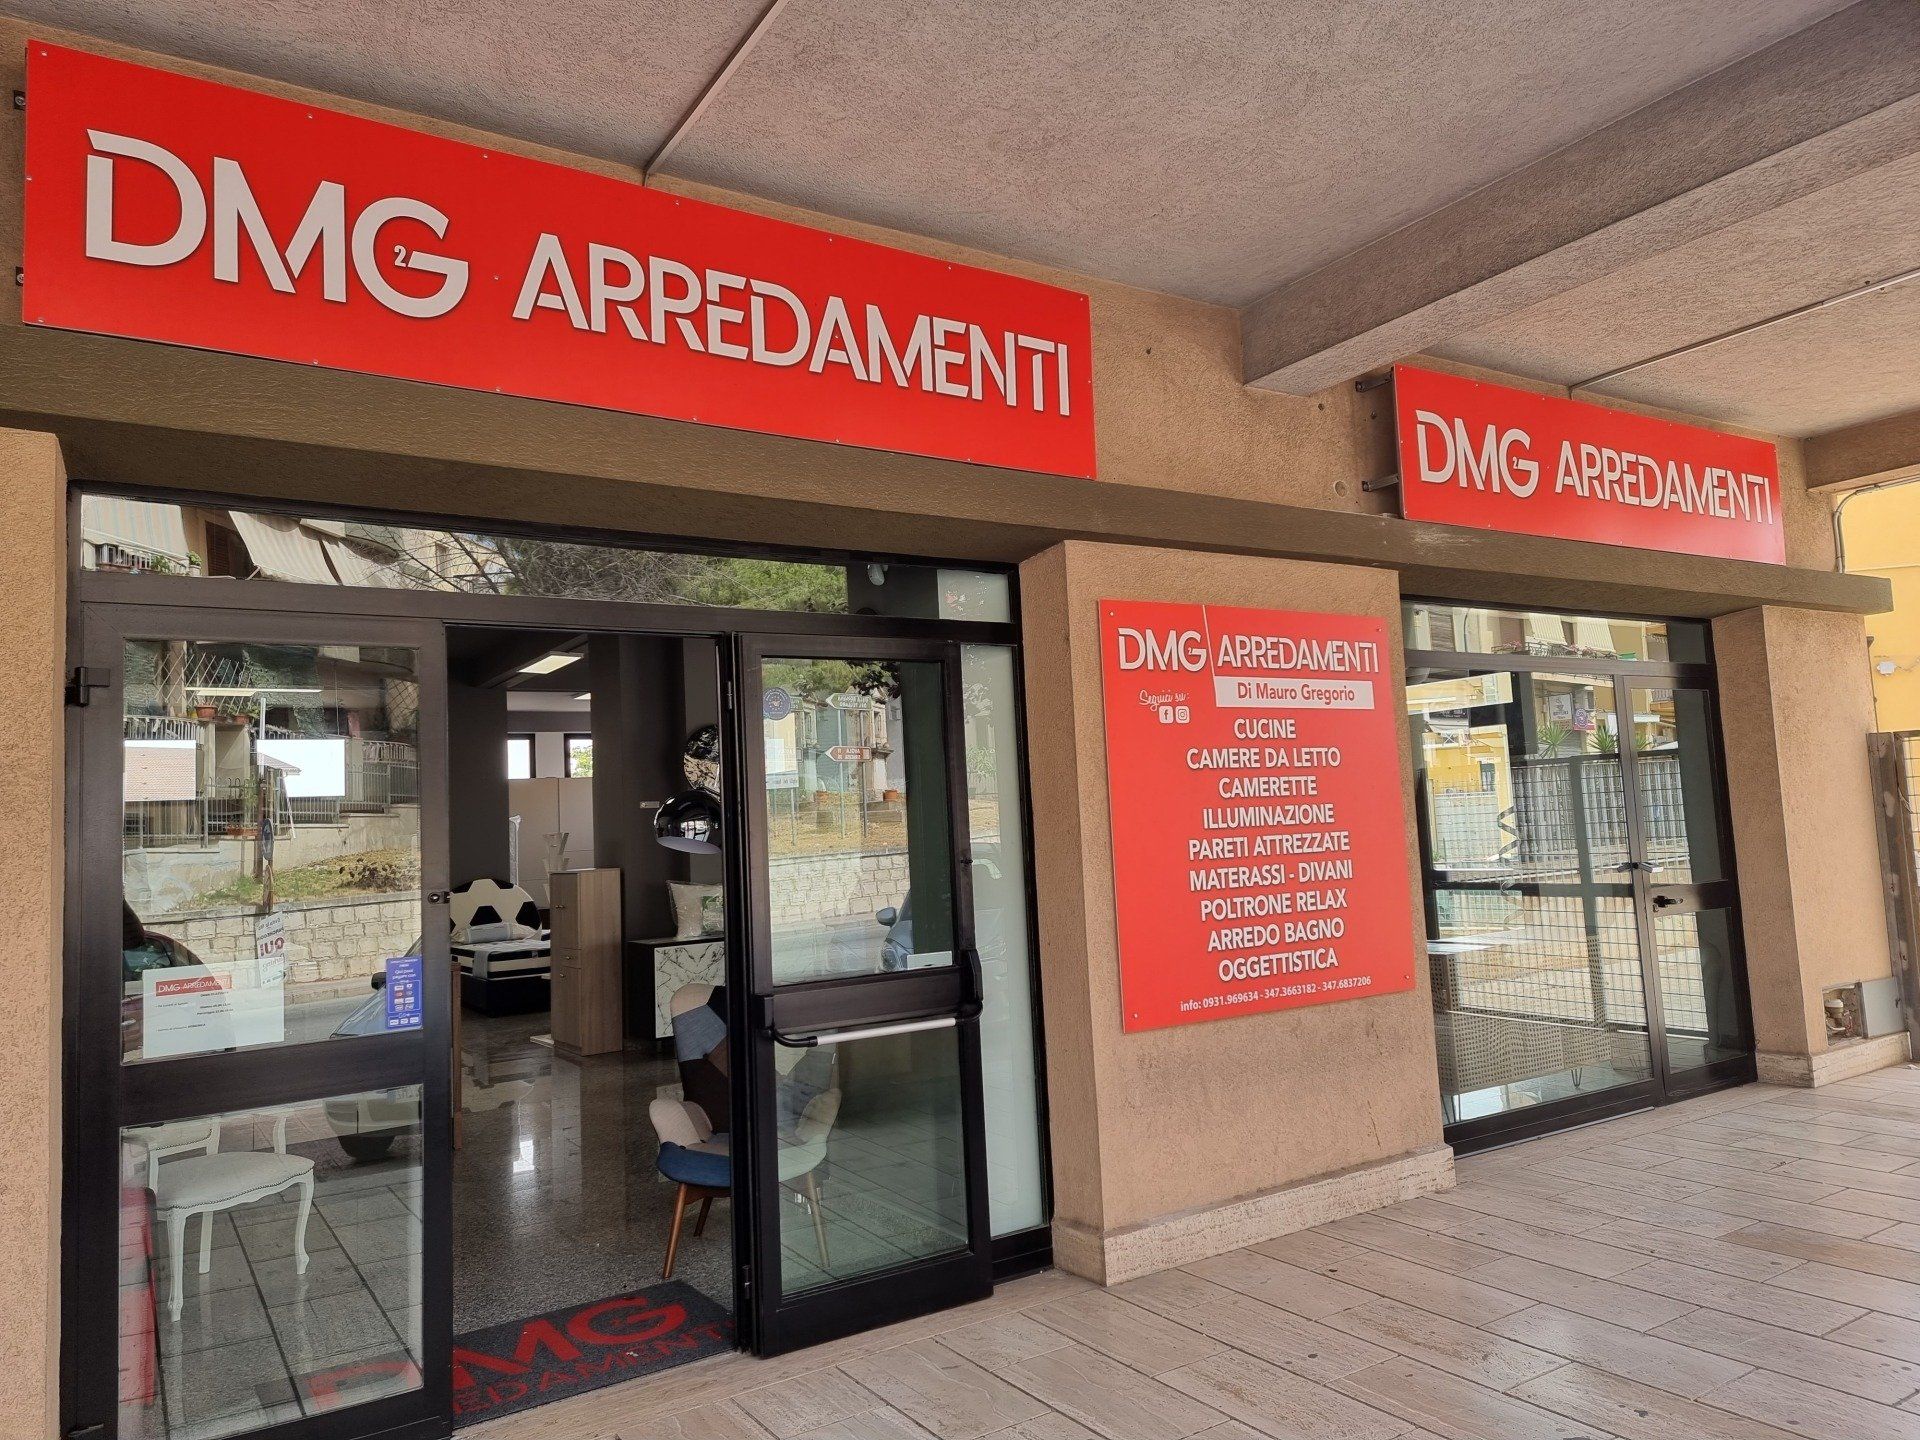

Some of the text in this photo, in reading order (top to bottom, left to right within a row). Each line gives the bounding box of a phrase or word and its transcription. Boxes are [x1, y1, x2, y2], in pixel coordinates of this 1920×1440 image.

[86, 129, 1071, 418] DMG ARREDAMENTI
[1416, 410, 1774, 525] DMG ARREDAMENTI
[1118, 627, 1379, 673] DMG ARREDAMENTI
[1237, 682, 1355, 705] Di Mauro Gregorio
[1233, 718, 1297, 739] CUCINE
[1186, 746, 1341, 769] CAMERE DA LETTO
[1218, 775, 1318, 798] CAMERETTE
[1203, 803, 1335, 829] ILLUMINAZIONE
[1188, 831, 1350, 861] PARETI ATTREZZATE
[1189, 863, 1286, 892] MATERASSI
[1298, 859, 1353, 883] DIVANI
[1200, 888, 1347, 922] POLTRONE RELAX
[1207, 917, 1345, 952] ARREDO BAGNO
[1218, 947, 1338, 982] OGGETTISTICA
[158, 983, 180, 993] DMG
[1180, 1000, 1201, 1012] info:
[1203, 990, 1259, 1008] 0931.969634
[1264, 983, 1316, 999] 347.3663182
[1322, 976, 1371, 991] 347.6837206
